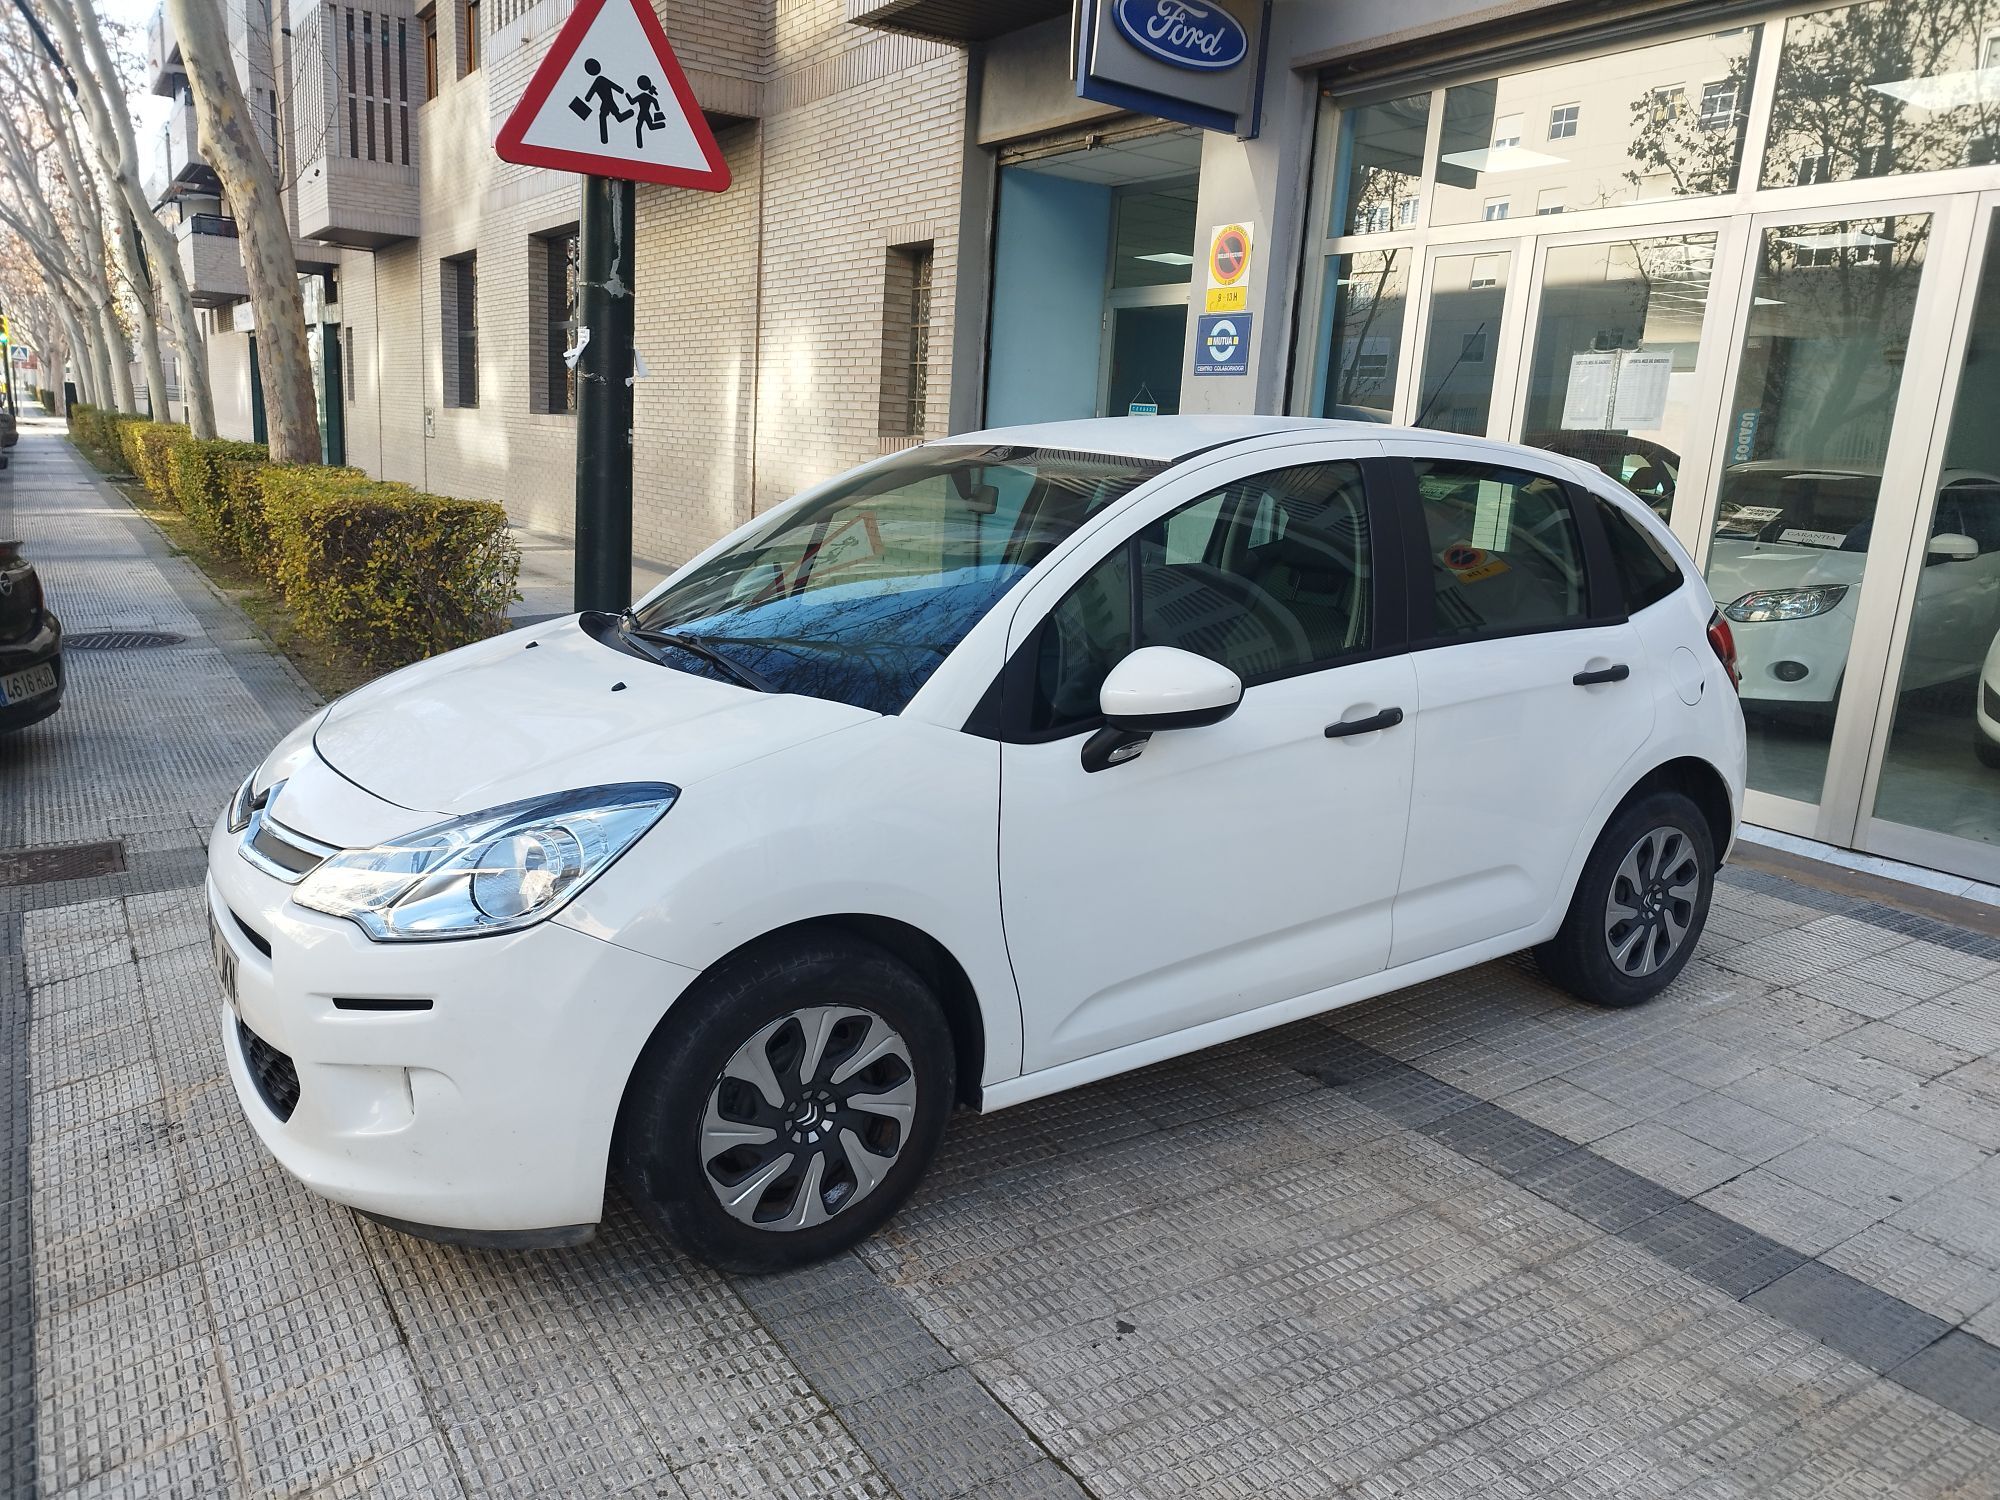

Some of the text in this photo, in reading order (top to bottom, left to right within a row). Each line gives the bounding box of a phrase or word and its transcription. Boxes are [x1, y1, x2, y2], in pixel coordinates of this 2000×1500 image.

[1147, 0, 1225, 56] Ford
[1213, 336, 1233, 346] MUTUA
[1735, 412, 1756, 461] USADOS
[7, 674, 35, 700] 4616
